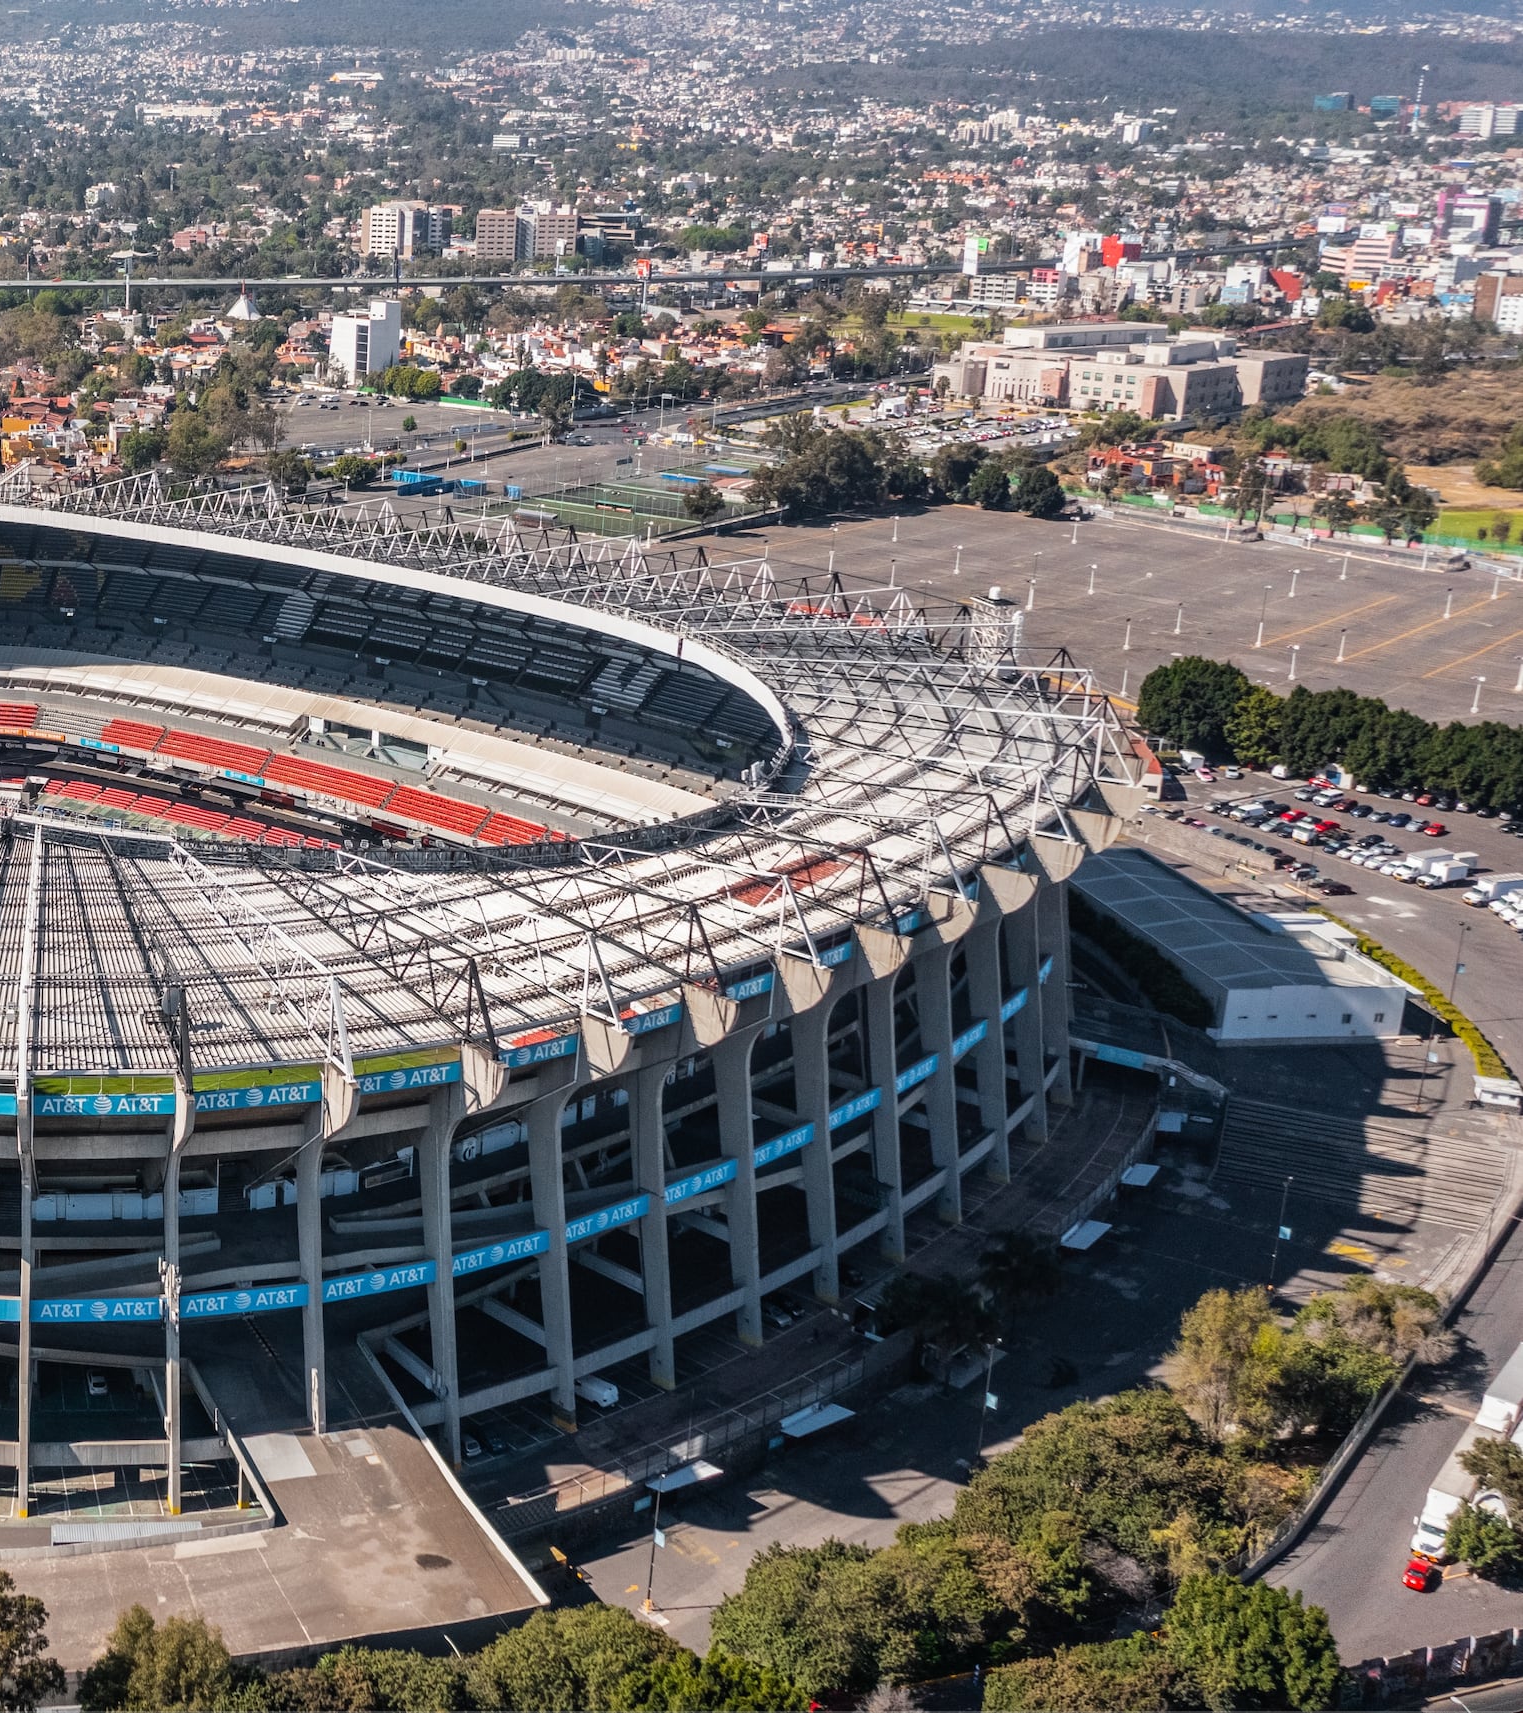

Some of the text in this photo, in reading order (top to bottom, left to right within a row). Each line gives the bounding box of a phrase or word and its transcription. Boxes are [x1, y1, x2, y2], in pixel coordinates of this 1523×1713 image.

[737, 978, 765, 999] AT&T
[643, 1009, 672, 1028] AT&T
[534, 1039, 568, 1060] AT&T
[357, 1066, 451, 1093] T&T AT&T
[41, 1096, 162, 1114] AT&T AT&T
[195, 1085, 311, 1110] AT&T AT&T
[785, 1129, 808, 1148] AT&T
[704, 1165, 730, 1185] AT&T
[565, 1201, 640, 1238] AT&T AT&T
[452, 1236, 541, 1273] AT&T AT&T
[326, 1266, 426, 1298] AT&T AT&T
[40, 1301, 156, 1318] AT&T AT&T
[186, 1289, 298, 1314] AT&T AT&T
